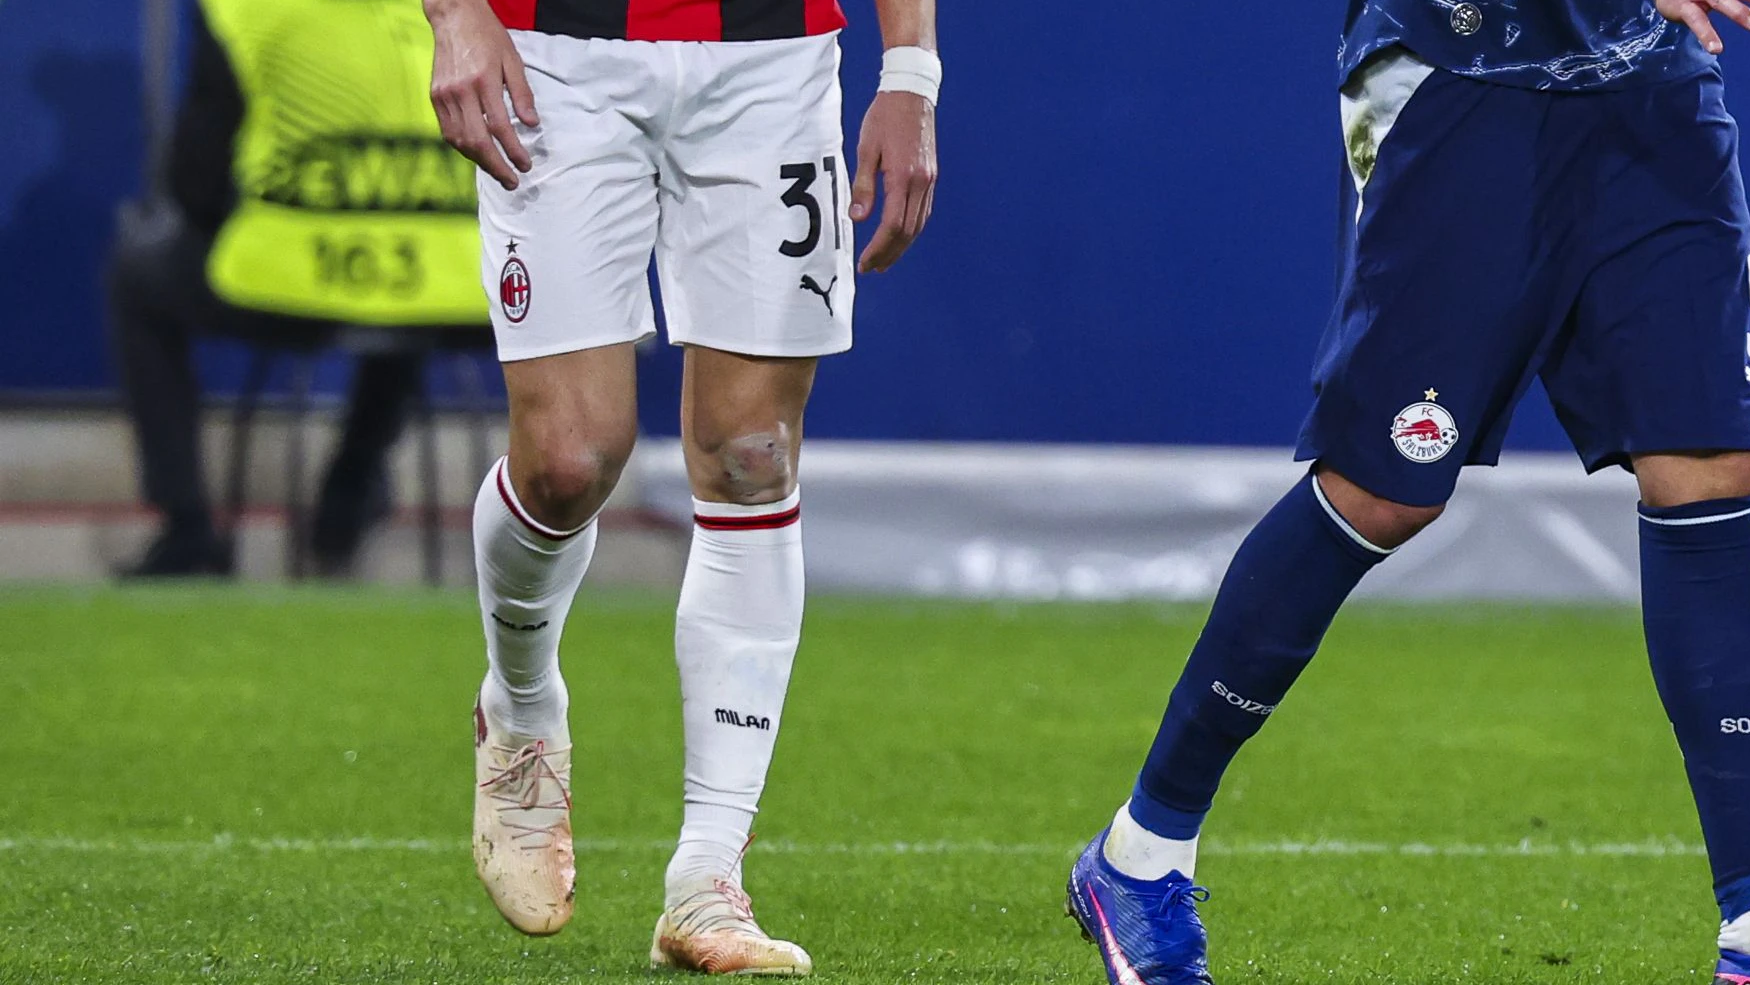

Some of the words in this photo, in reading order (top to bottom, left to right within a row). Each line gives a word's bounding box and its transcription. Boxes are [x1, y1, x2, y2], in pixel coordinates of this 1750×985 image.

[778, 156, 841, 258] 31
[1421, 407, 1434, 417] FC
[1402, 438, 1443, 458] SALZBURG
